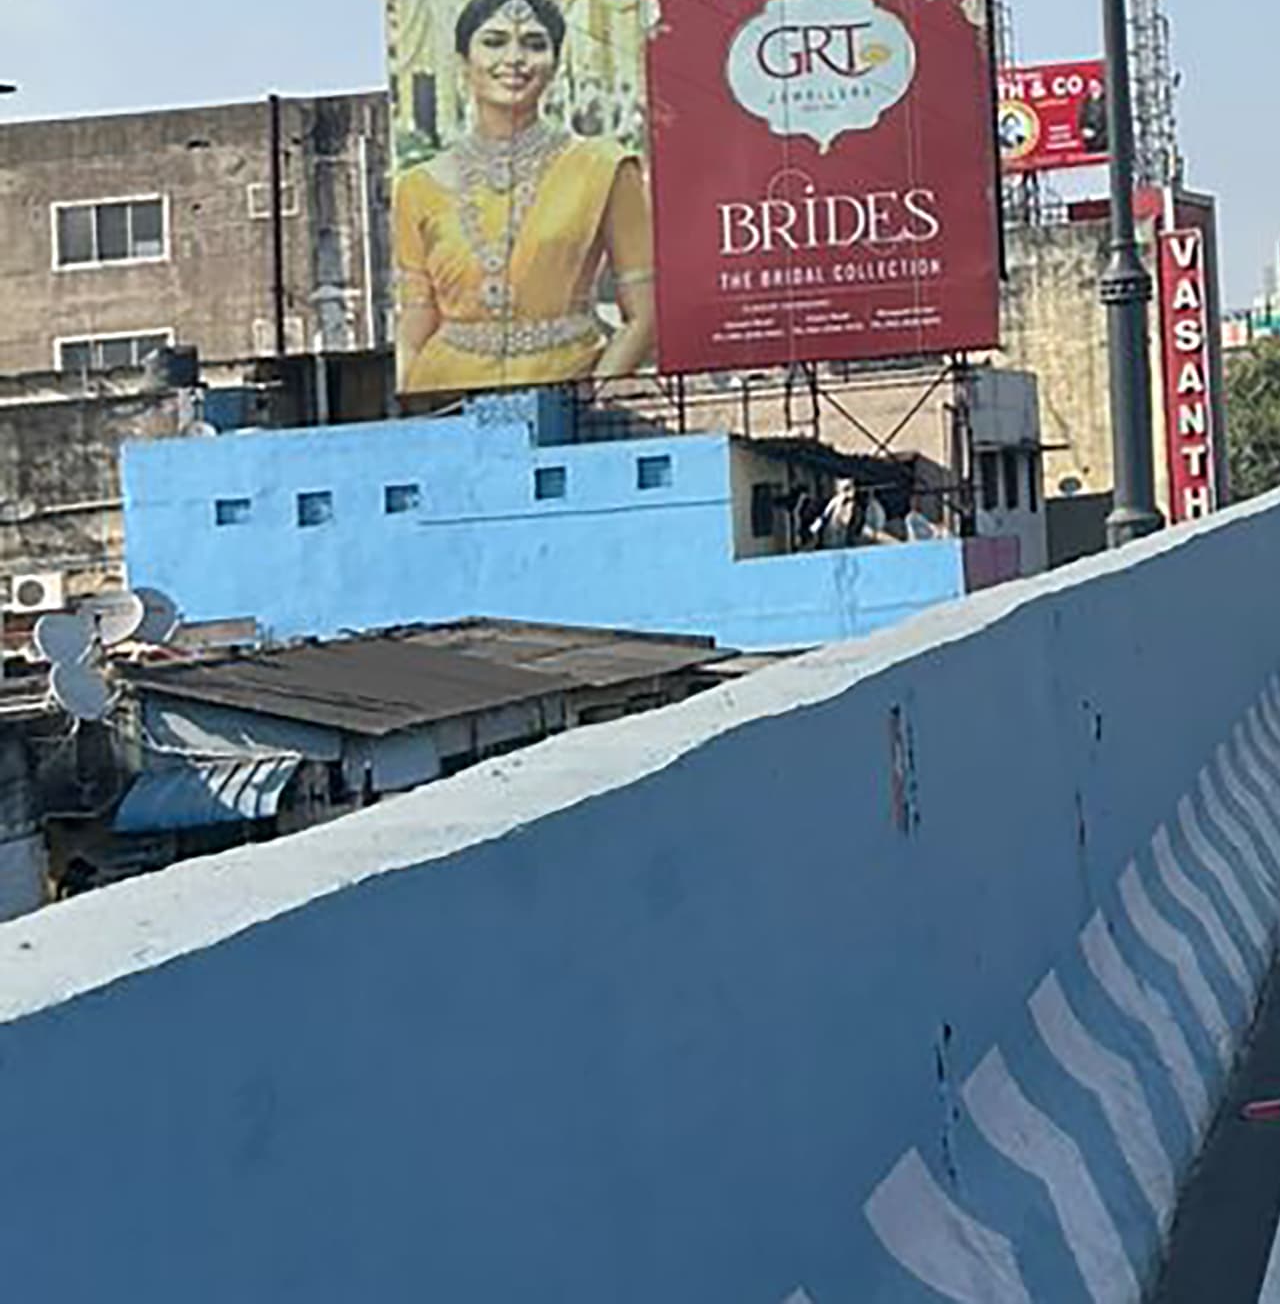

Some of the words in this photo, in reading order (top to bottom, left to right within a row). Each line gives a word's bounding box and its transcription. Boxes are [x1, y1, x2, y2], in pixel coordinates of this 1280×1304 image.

[756, 22, 872, 79] GRT
[1052, 74, 1083, 96] CO
[720, 271, 751, 290] THE
[761, 267, 824, 288] BRIDAL
[832, 258, 941, 282] COLLECTION
[1168, 237, 1208, 520] VASANTH
